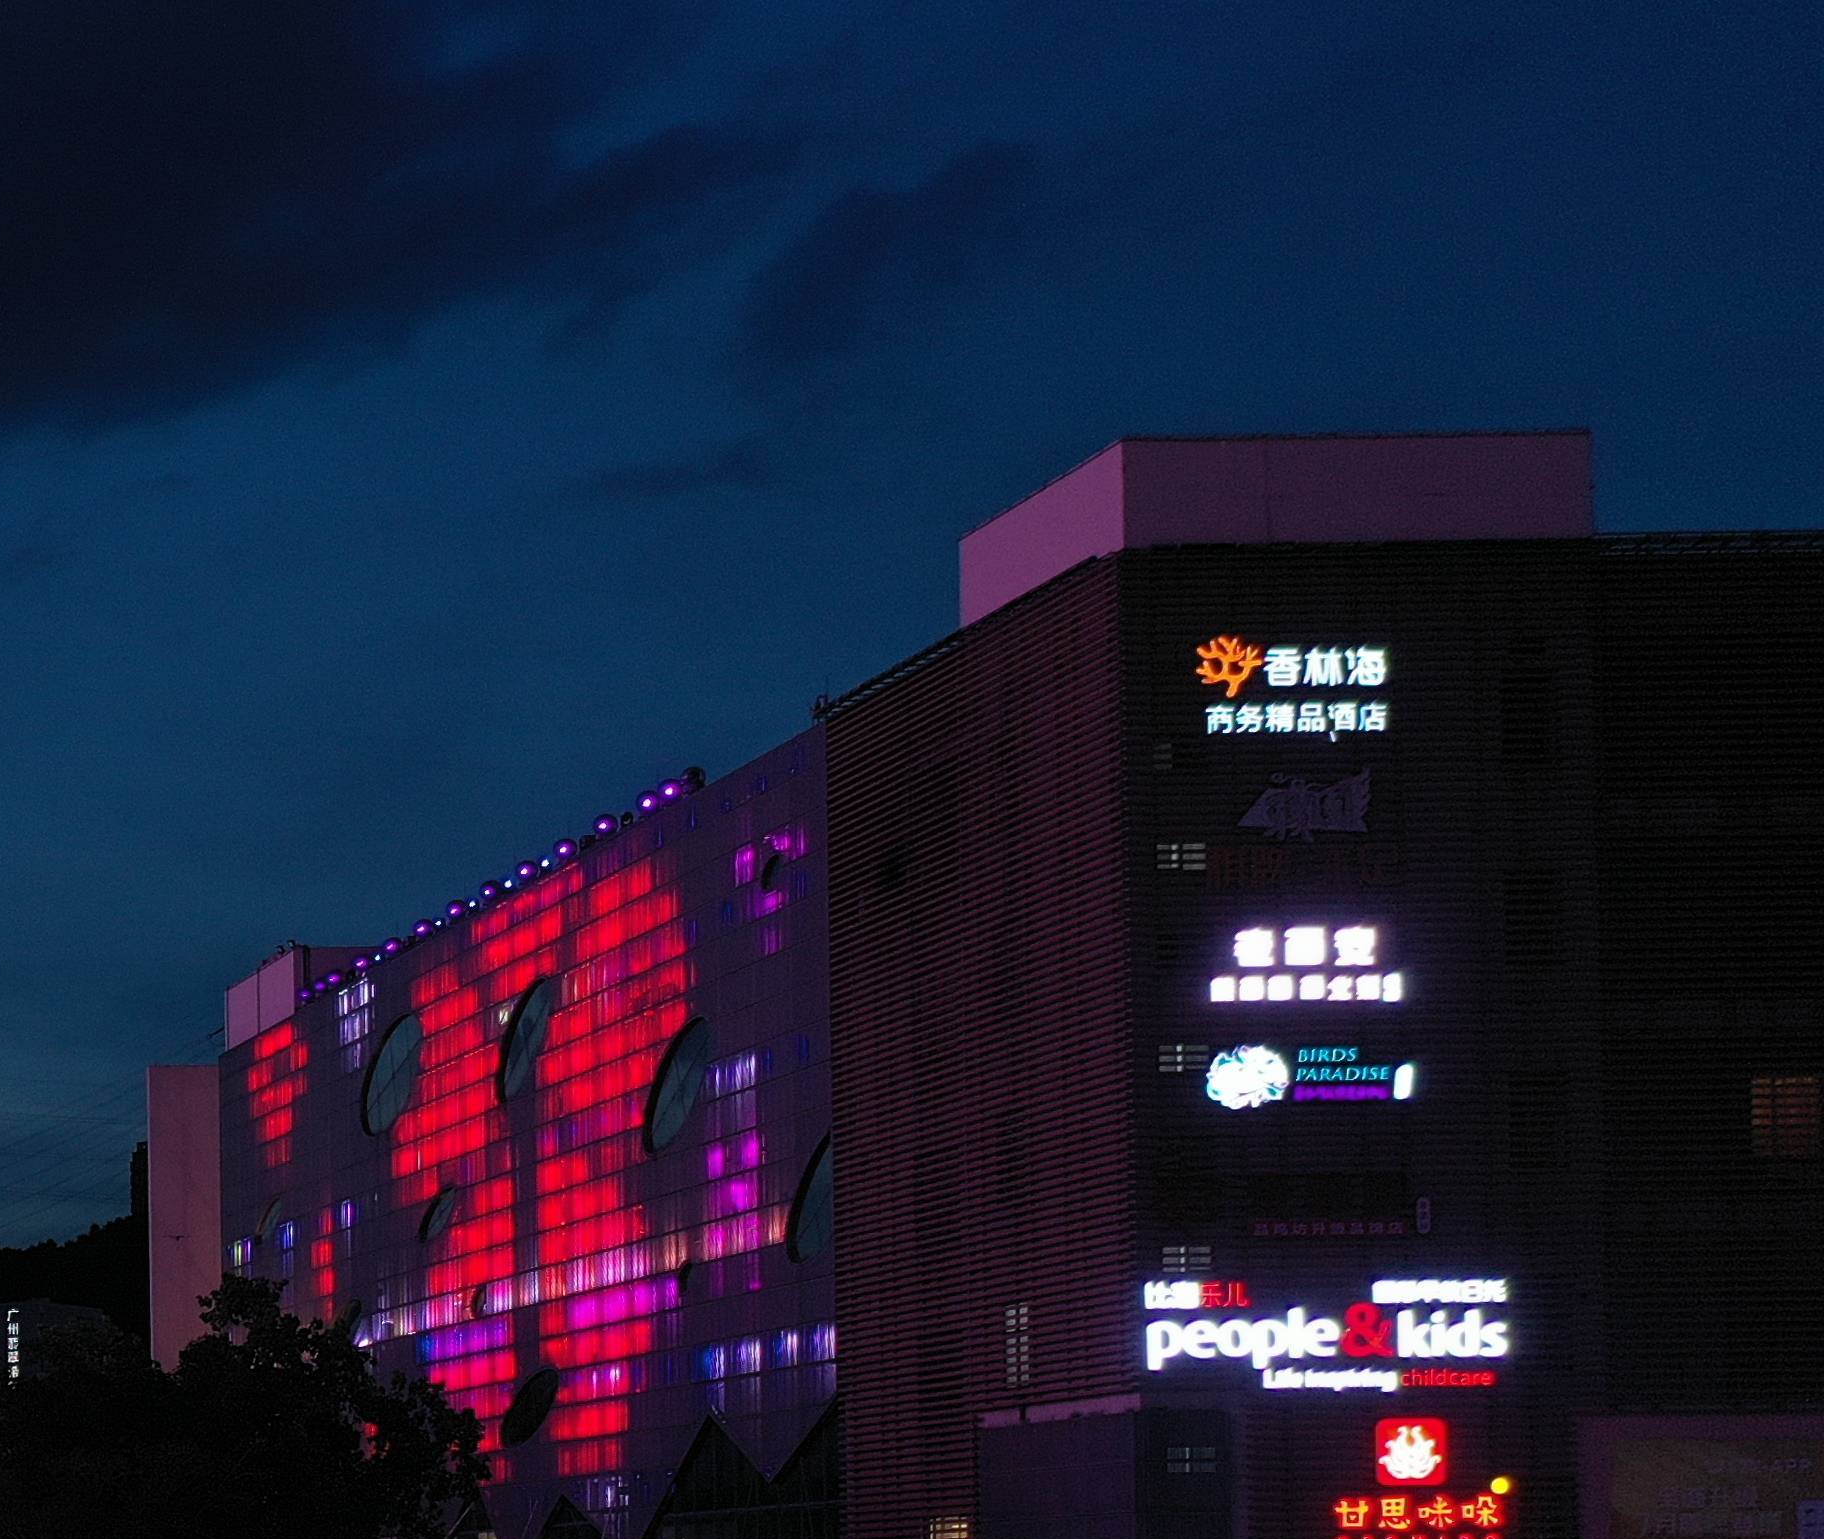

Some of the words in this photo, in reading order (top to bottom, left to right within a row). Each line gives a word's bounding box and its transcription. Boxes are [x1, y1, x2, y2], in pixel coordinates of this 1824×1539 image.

[1264, 646, 1386, 687] 香林海
[1206, 702, 1387, 733] 商务精品酒店
[1298, 1049, 1358, 1062] BIRDS
[1296, 1067, 1389, 1081] PARADISE
[1400, 1369, 1493, 1386] childcare
